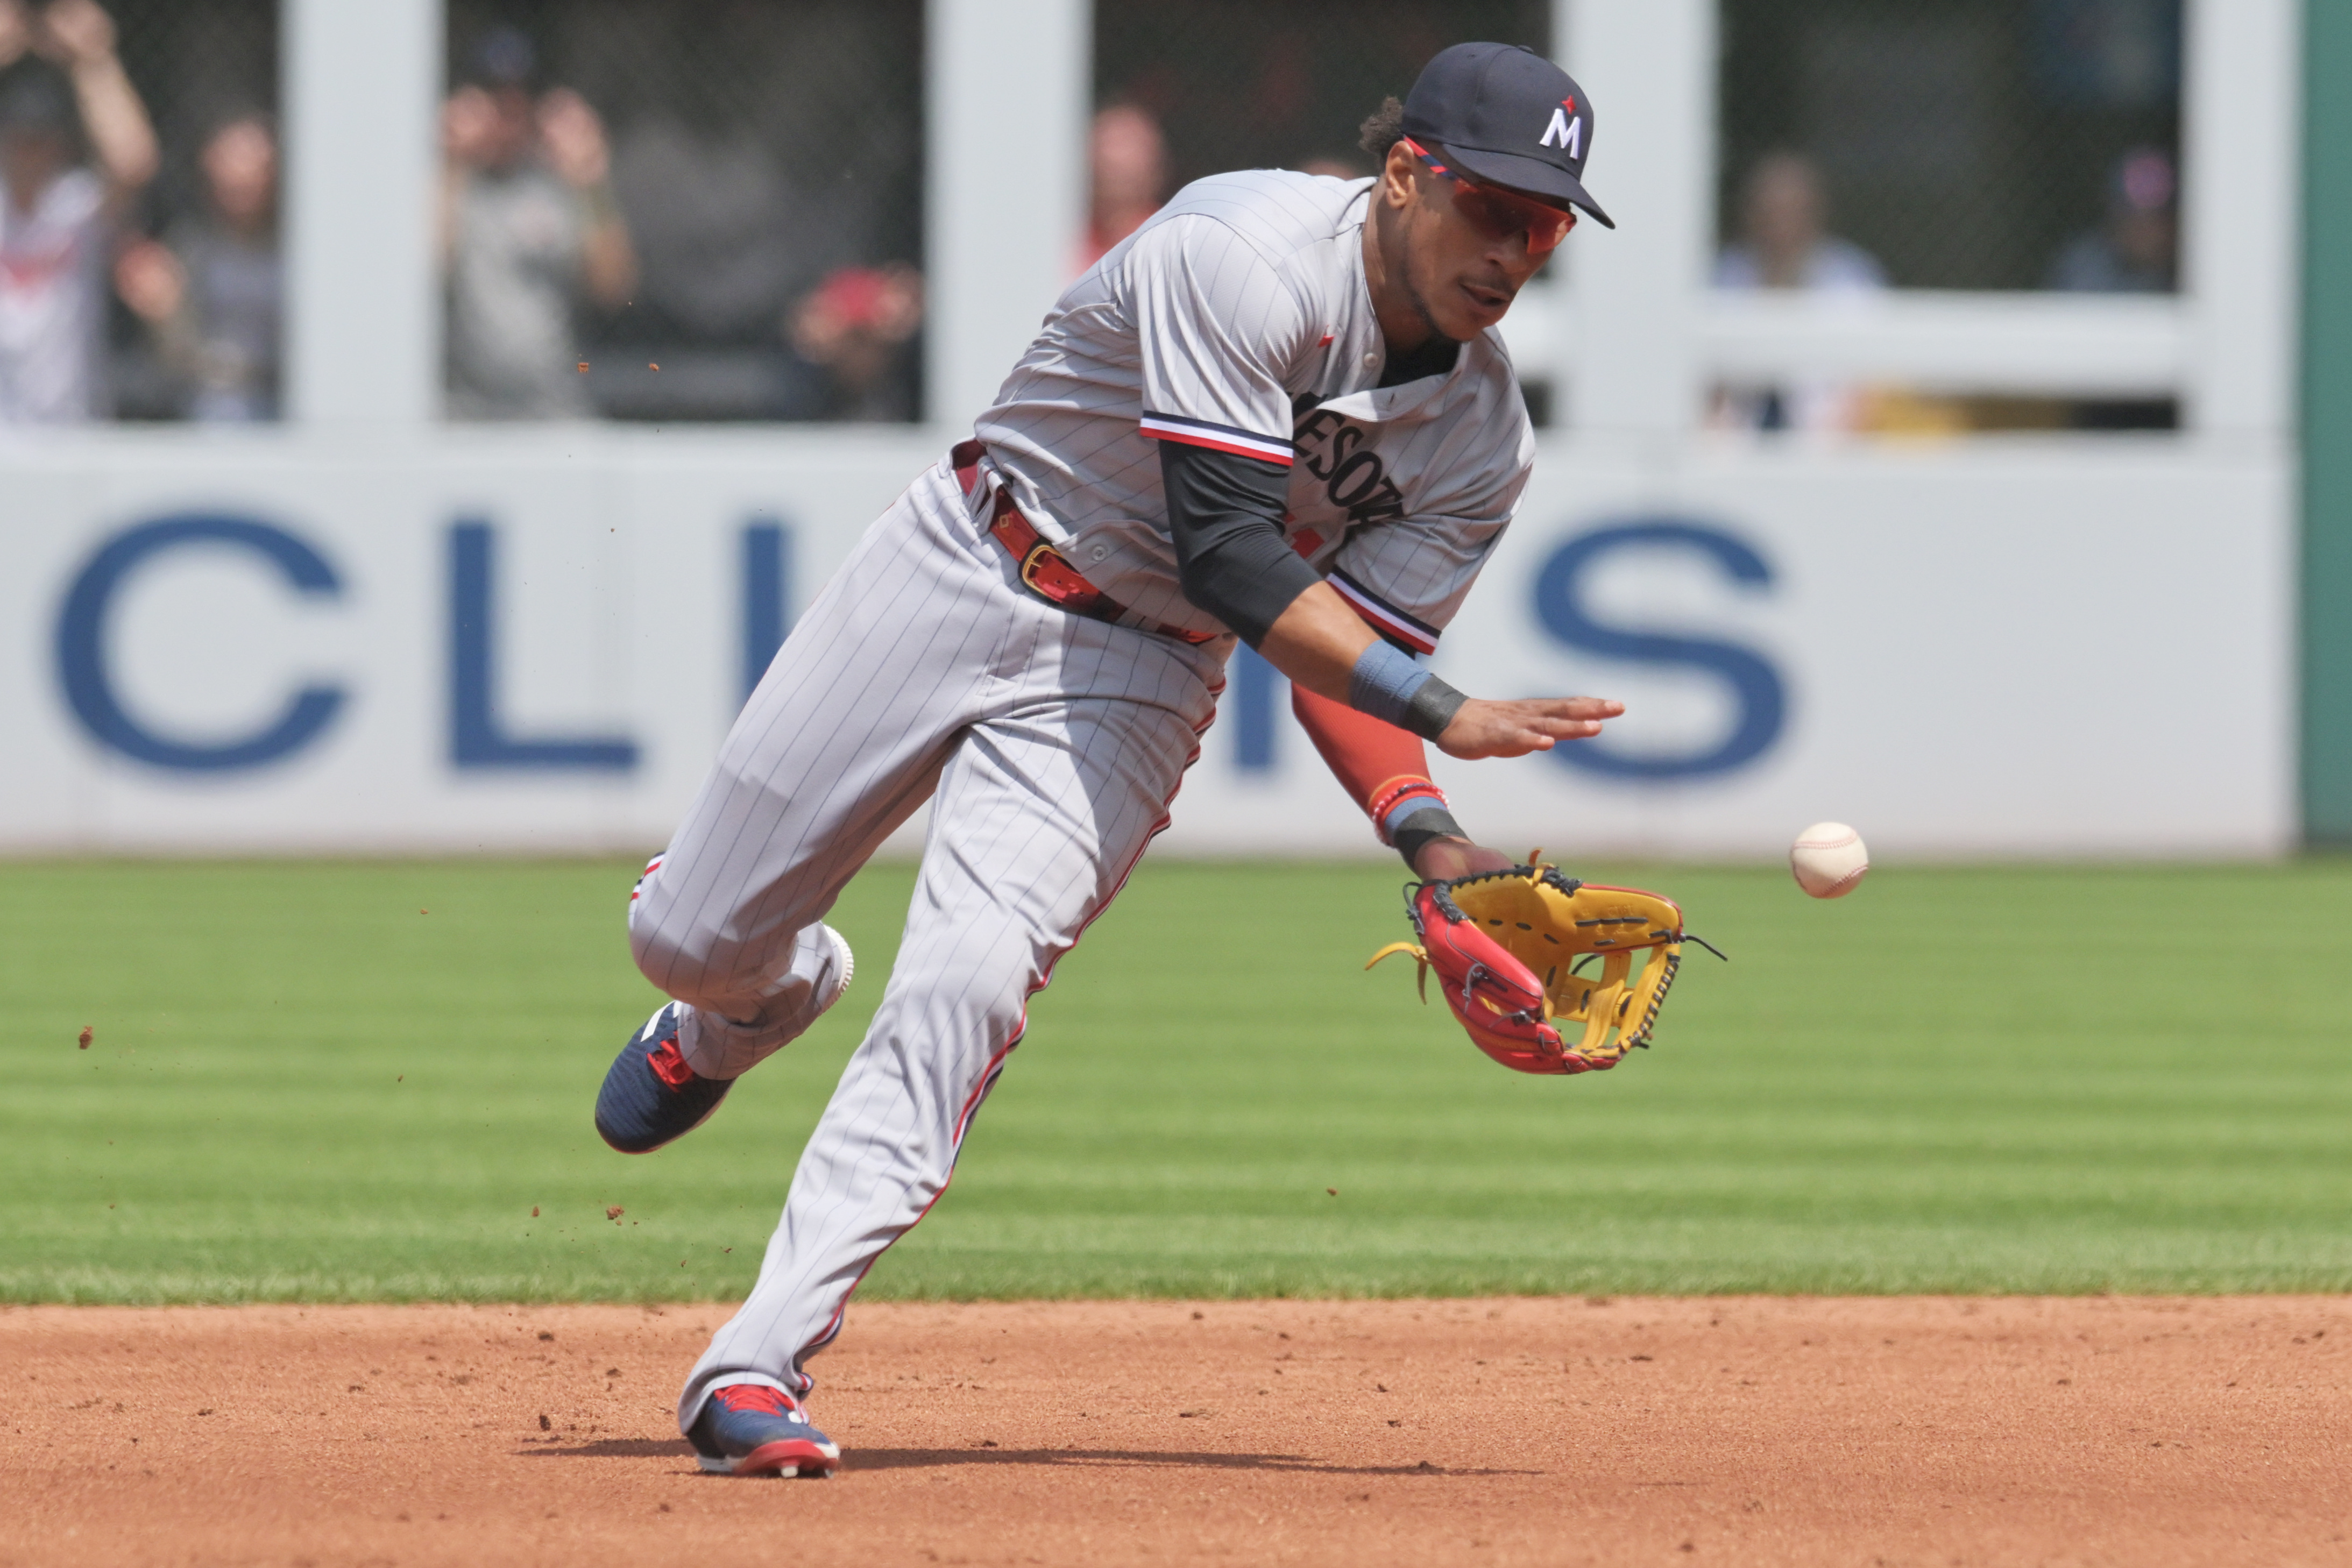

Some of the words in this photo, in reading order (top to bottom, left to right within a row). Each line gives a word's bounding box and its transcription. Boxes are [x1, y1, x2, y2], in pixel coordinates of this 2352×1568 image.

[1539, 108, 1581, 160] M
[1287, 392, 1406, 534] ESOT
[53, 513, 1790, 781] CLIS
